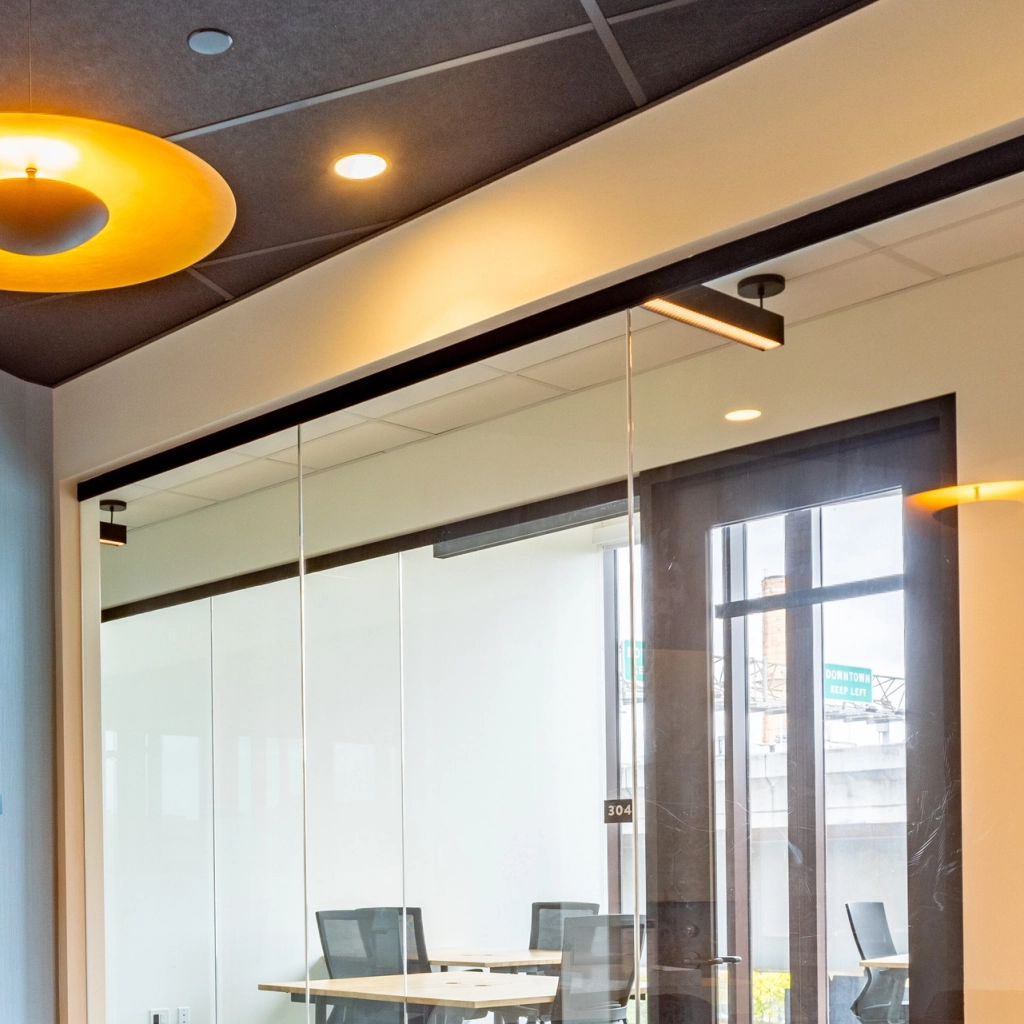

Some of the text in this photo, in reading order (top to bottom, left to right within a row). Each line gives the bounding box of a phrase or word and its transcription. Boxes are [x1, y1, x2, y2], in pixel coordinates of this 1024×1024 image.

[826, 669, 870, 683] DOWNTOWN
[830, 685, 866, 697] KEEP LEFT
[608, 804, 632, 816] 304
